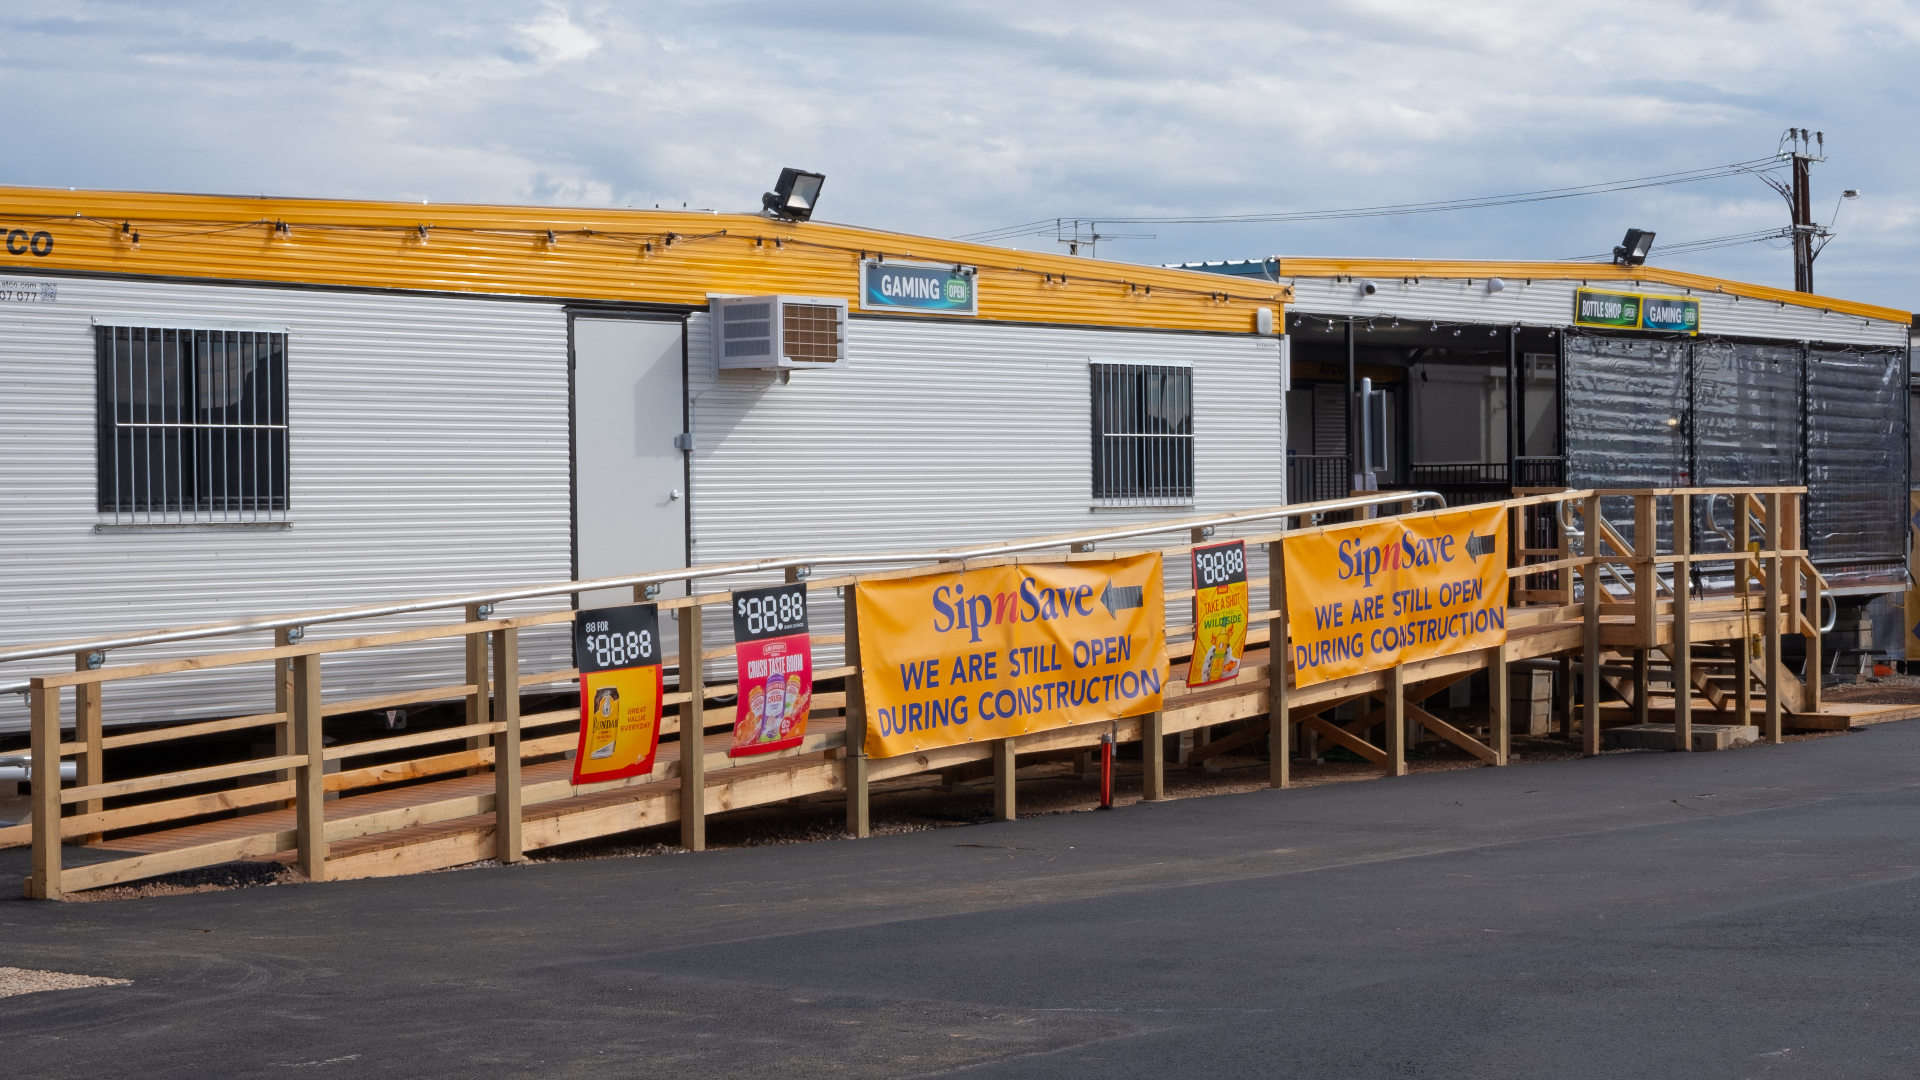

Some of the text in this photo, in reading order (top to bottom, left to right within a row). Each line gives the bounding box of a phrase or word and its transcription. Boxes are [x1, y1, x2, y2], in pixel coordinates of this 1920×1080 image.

[17, 291, 37, 302] 077
[881, 274, 965, 300] GAMING OPEN
[1582, 299, 1635, 319] BOTTLE SHOP OPEN
[1649, 306, 1695, 324] GAMING OPEN
[1196, 548, 1244, 585] $88.88
[737, 592, 803, 634] $88.88
[1204, 592, 1240, 615] TAKE A SHOT
[1222, 609, 1234, 617] THE
[1315, 577, 1483, 631] WE ARE STILL OPEN
[585, 620, 609, 633] 88 FOR
[1296, 606, 1505, 671] DURING CONSTRUCTION
[586, 629, 652, 667] $88.88
[748, 653, 803, 679] CRUSH TASTE BOOM
[900, 634, 1131, 692] WE ARE STILL OPEN
[628, 706, 647, 715] GREAT
[878, 668, 1161, 738] DURING CONSTRUCTION
[620, 722, 651, 733] EVERYDAY
[628, 715, 647, 723] VALUE
